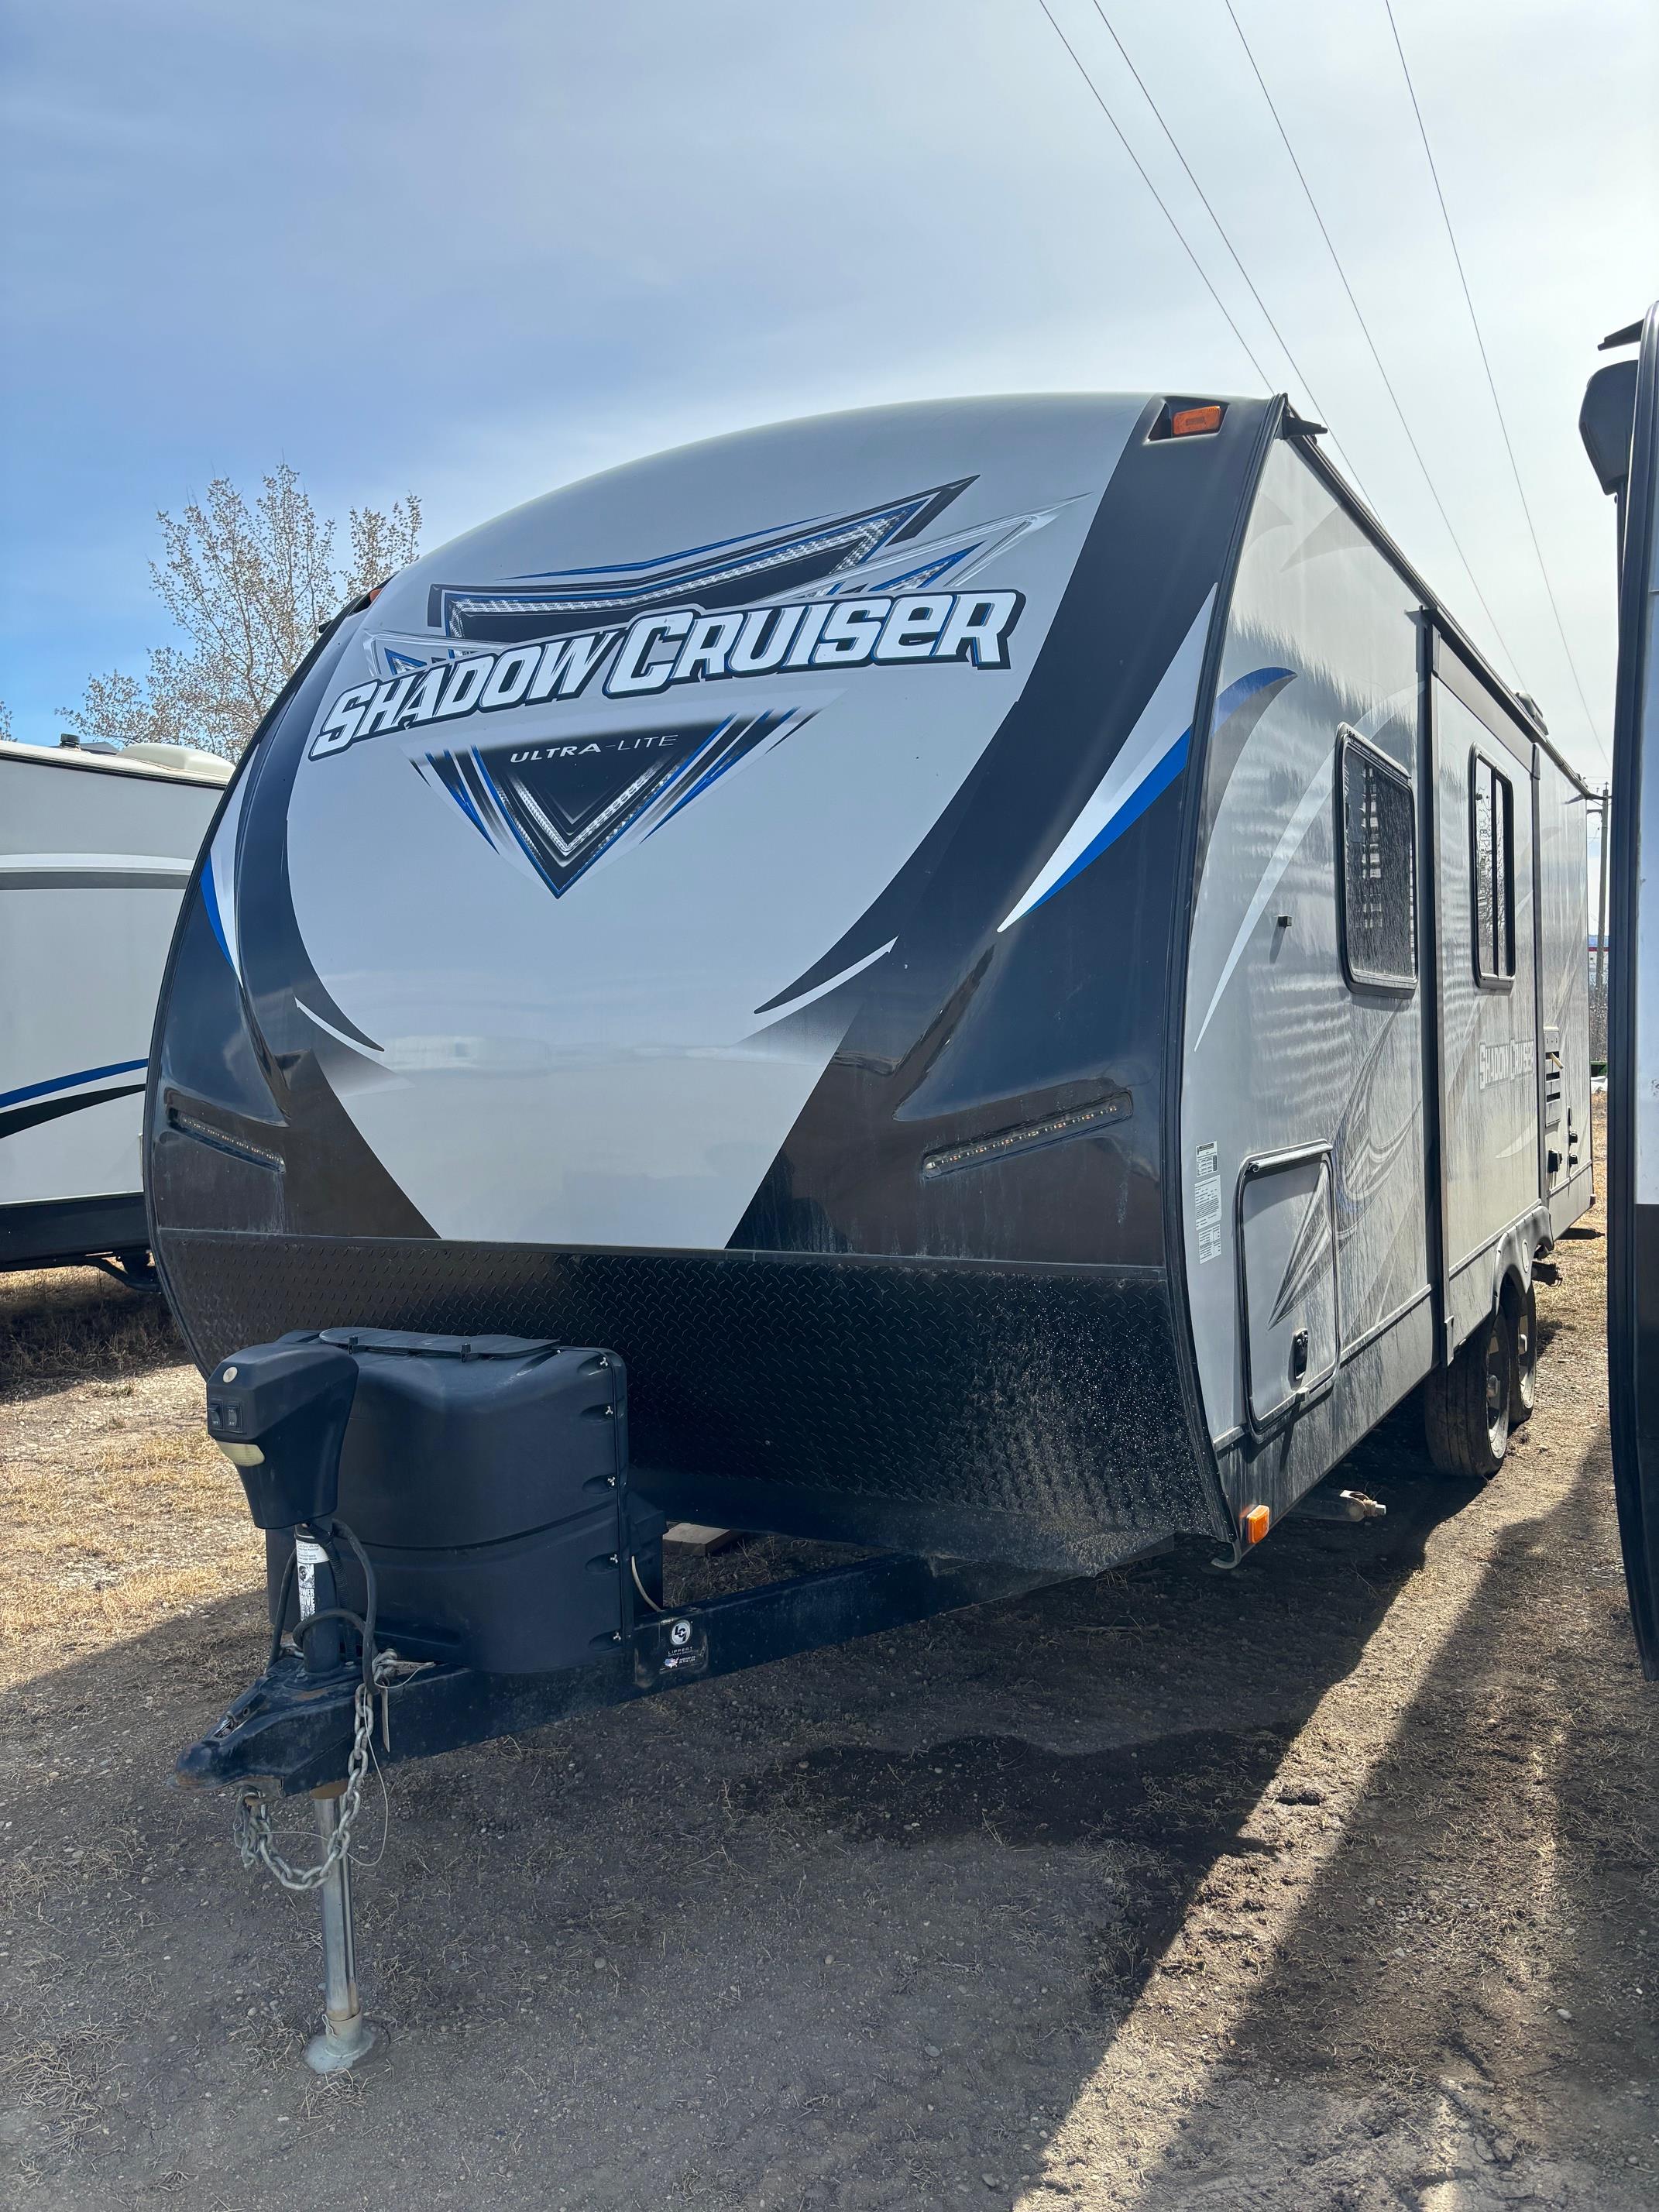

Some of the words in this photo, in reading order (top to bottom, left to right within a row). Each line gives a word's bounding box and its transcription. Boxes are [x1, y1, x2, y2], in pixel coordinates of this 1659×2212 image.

[311, 628, 624, 759] SHADOW
[510, 734, 679, 764] ULTRA-LITE
[1479, 1043, 1509, 1090] SHADOW
